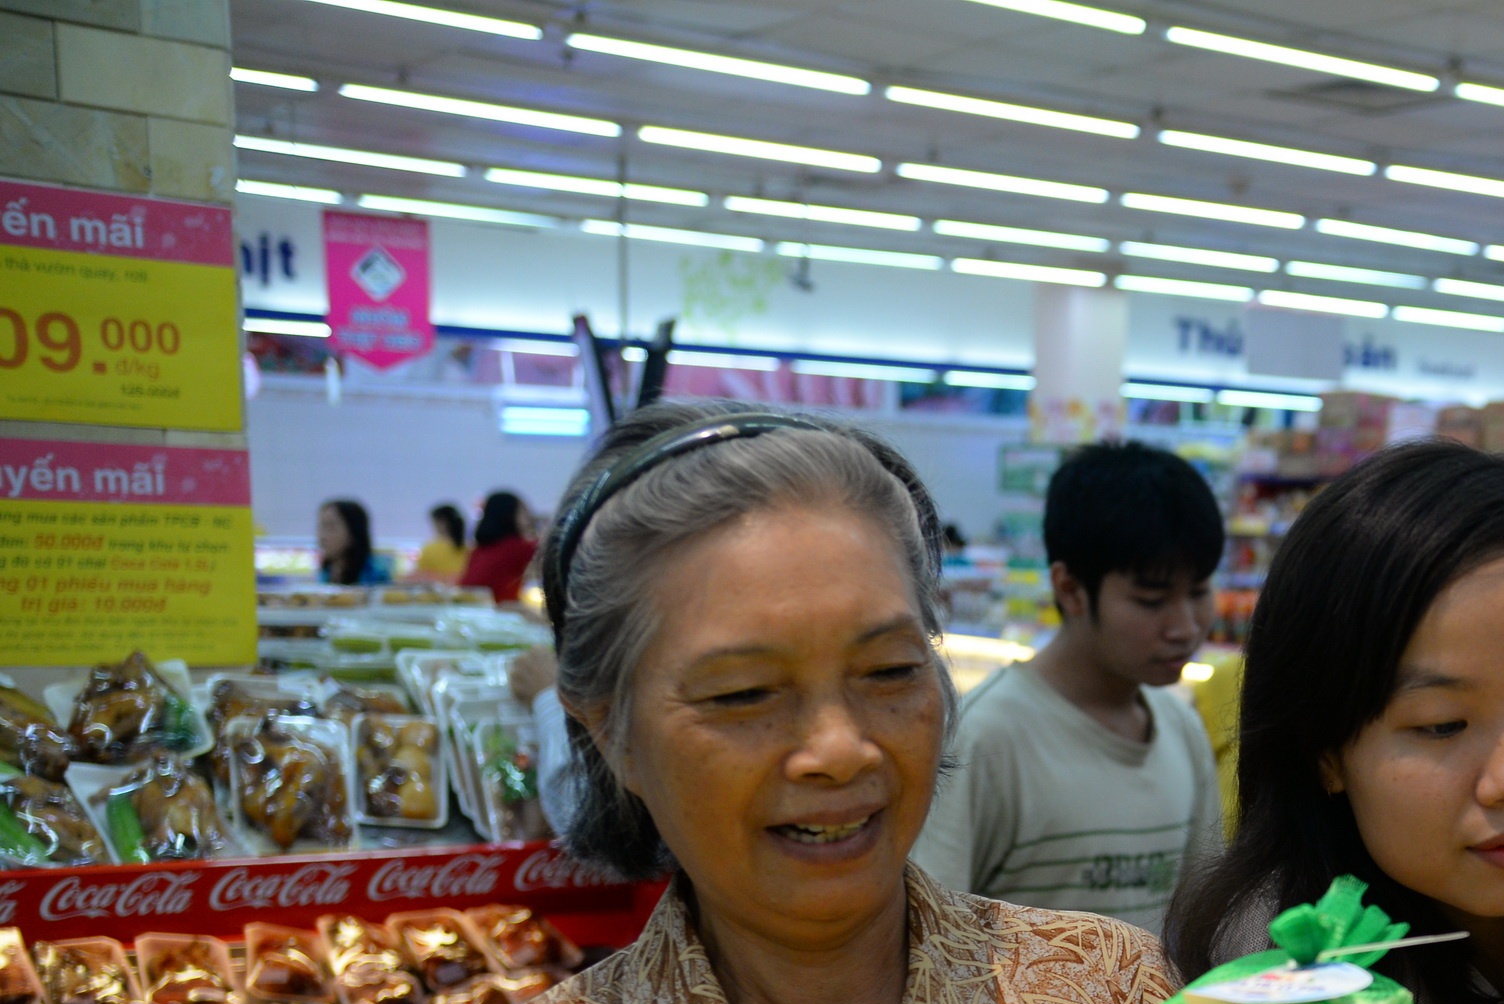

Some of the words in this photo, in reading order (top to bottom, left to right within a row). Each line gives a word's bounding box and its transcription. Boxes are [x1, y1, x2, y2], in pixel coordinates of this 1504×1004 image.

[70, 211, 145, 248] mãi
[0, 453, 81, 497] yến
[94, 461, 165, 495] mãi
